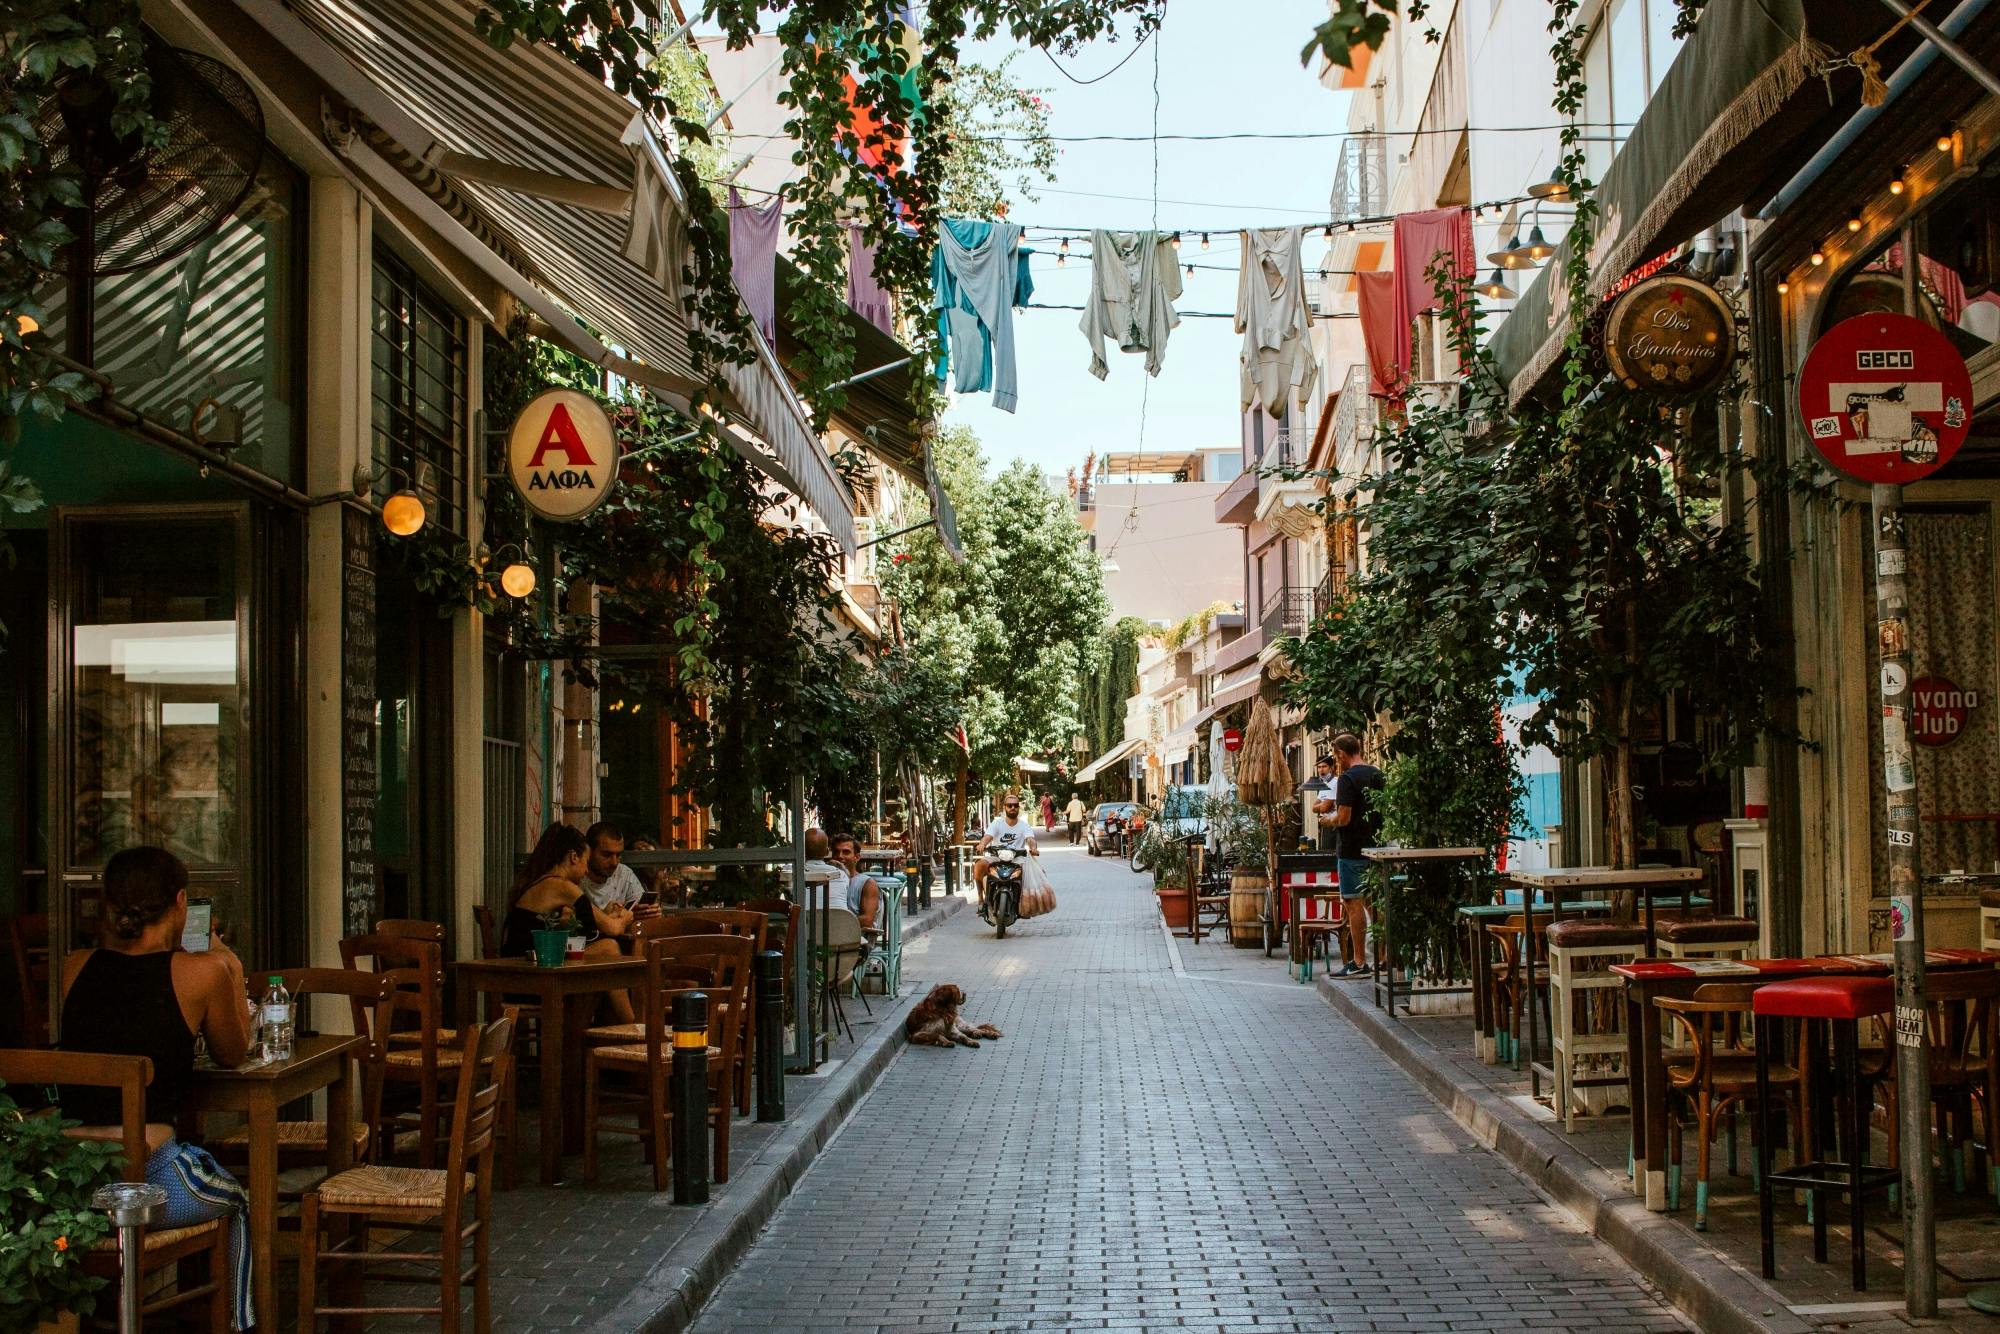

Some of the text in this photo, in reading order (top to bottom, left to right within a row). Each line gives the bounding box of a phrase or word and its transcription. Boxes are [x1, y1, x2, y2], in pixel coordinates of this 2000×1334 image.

[1652, 308, 1690, 332] Dos
[1627, 333, 1716, 361] Gardenias
[528, 470, 595, 490] ΑΛΦΑ
[1912, 690, 1978, 709] vana
